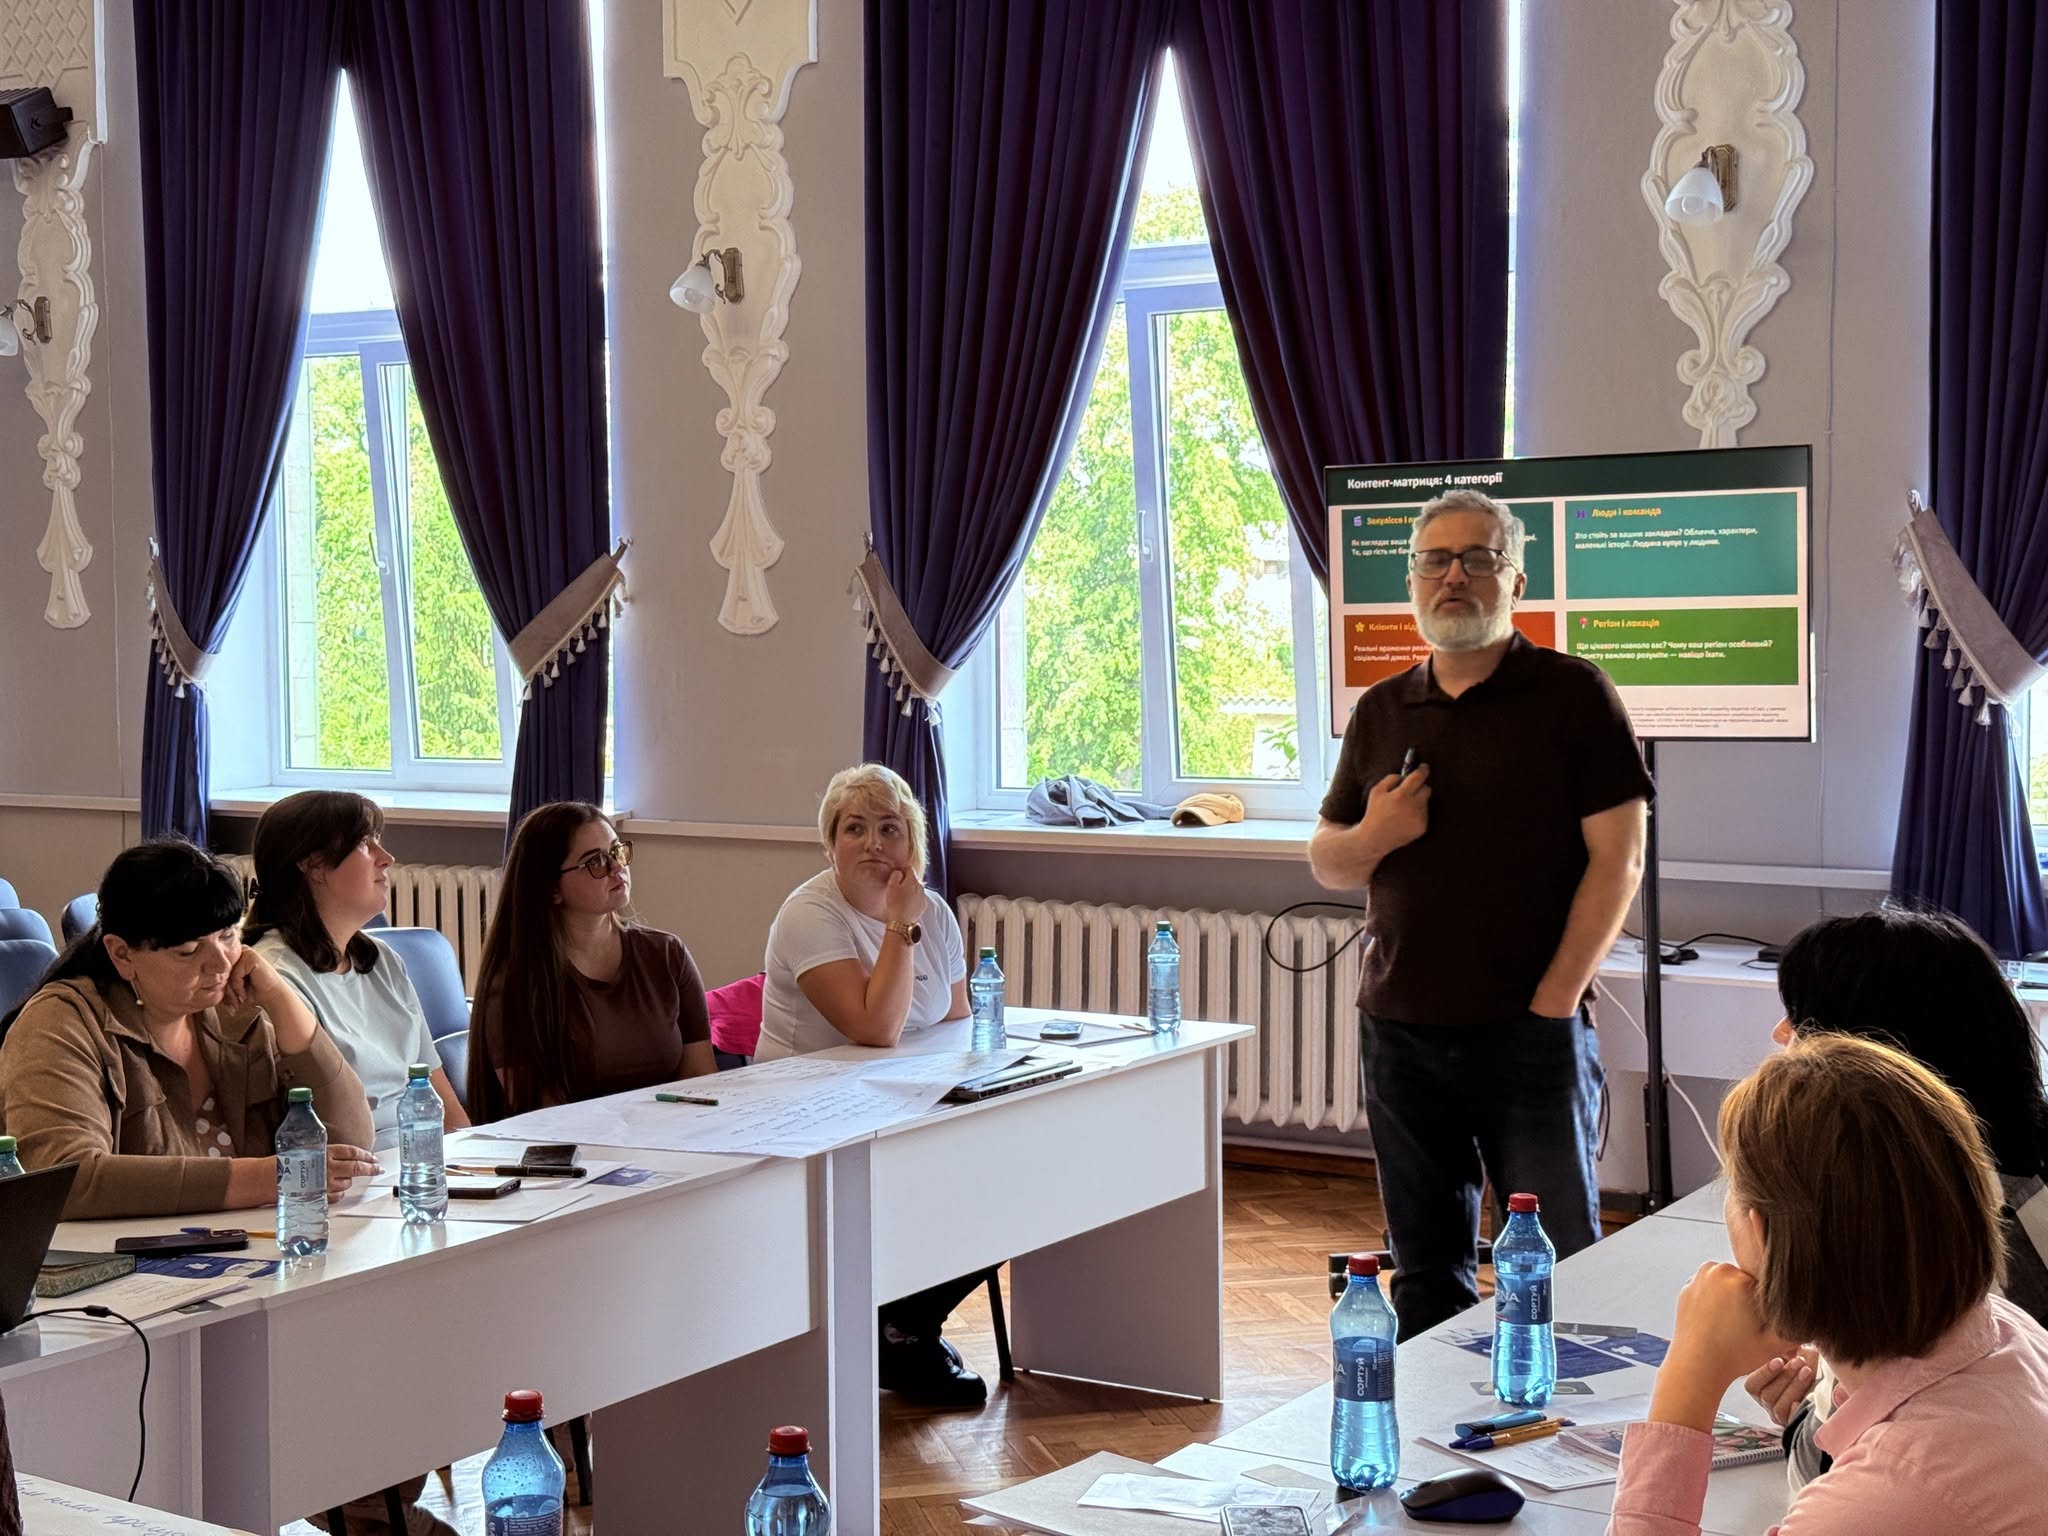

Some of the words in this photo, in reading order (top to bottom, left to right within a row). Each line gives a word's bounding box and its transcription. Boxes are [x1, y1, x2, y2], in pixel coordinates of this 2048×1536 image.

[1347, 475, 1443, 489] Контент-матриця:
[1444, 474, 1452, 485] 4
[1454, 472, 1504, 485] категорії
[1591, 508, 1617, 518] Люди
[1623, 507, 1662, 517] команда
[1574, 532, 1588, 540] Хто
[1592, 618, 1620, 629] Регіон
[1626, 618, 1660, 629] локація
[1651, 640, 1667, 649] вас?
[1667, 641, 1687, 650] Чому
[1704, 641, 1727, 650] регіон
[1528, 1284, 1538, 1321] СОРТУЙ
[1355, 1357, 1365, 1397] СОРТУЙ
